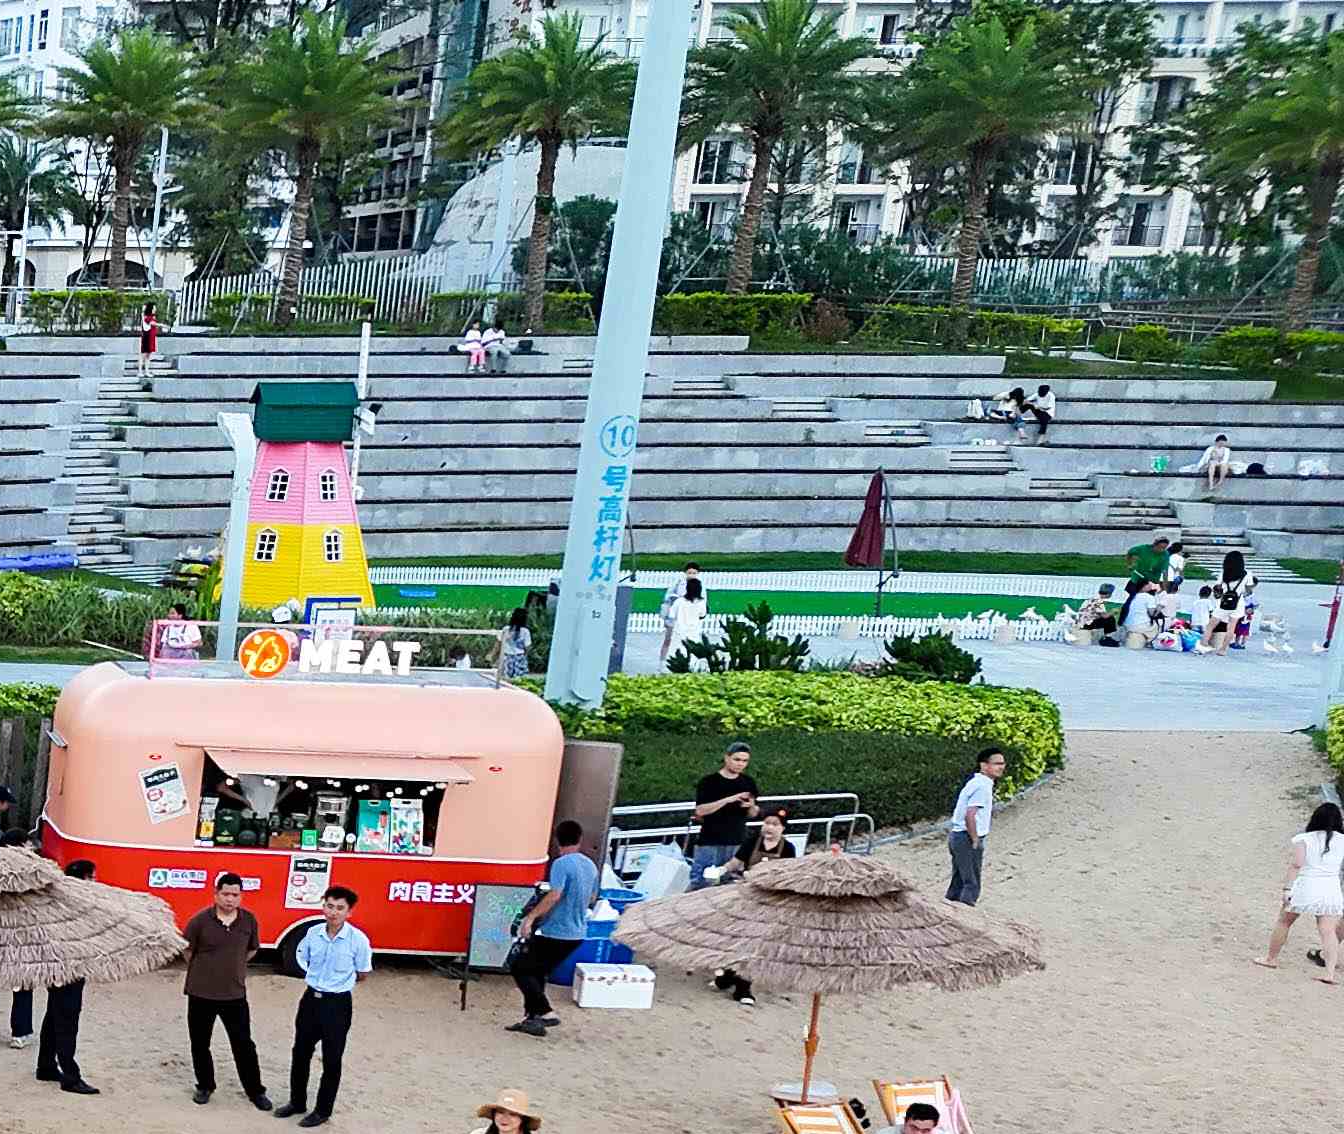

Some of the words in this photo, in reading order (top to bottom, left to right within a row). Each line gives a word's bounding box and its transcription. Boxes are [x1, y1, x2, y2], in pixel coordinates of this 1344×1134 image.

[588, 464, 628, 583] 号高杆灯
[298, 639, 421, 676] MEAT
[389, 882, 474, 904] 肉食主义
